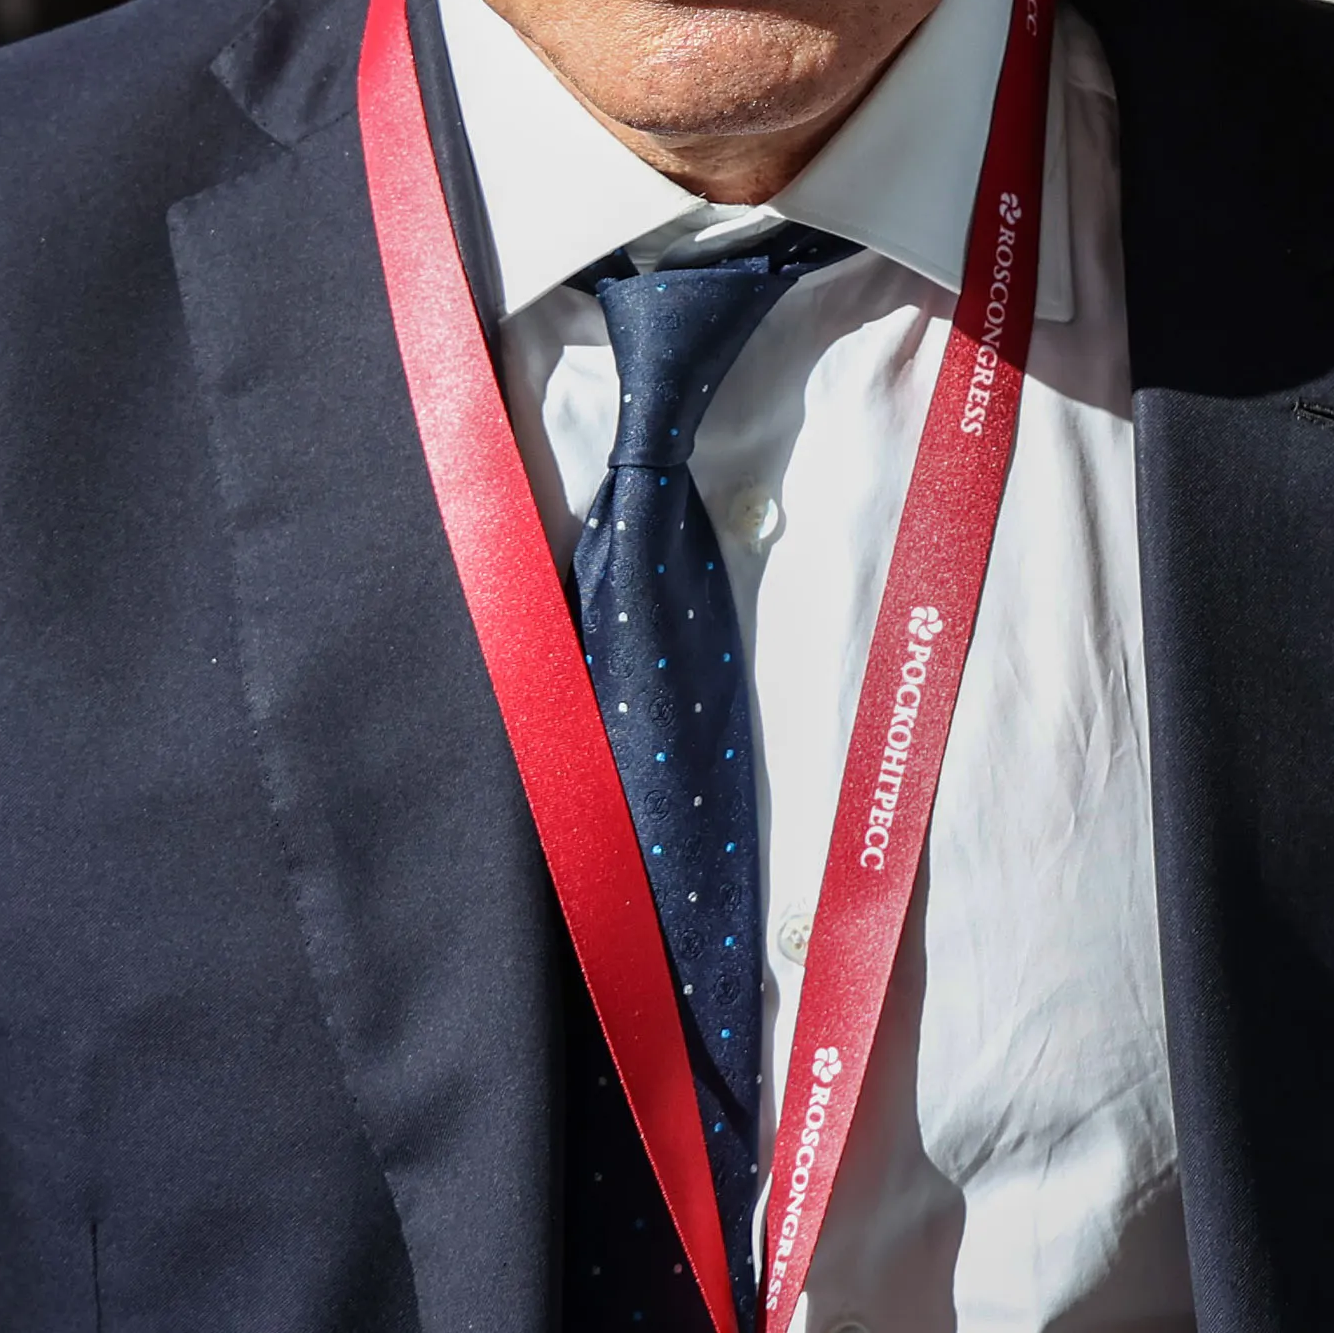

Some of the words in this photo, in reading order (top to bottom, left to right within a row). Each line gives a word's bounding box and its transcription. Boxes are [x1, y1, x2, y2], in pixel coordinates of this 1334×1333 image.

[961, 226, 1016, 437] ROSCONGRESS
[860, 641, 932, 871] РОСКОНГРЕСС
[766, 1083, 832, 1311] ROSCONGRESS
